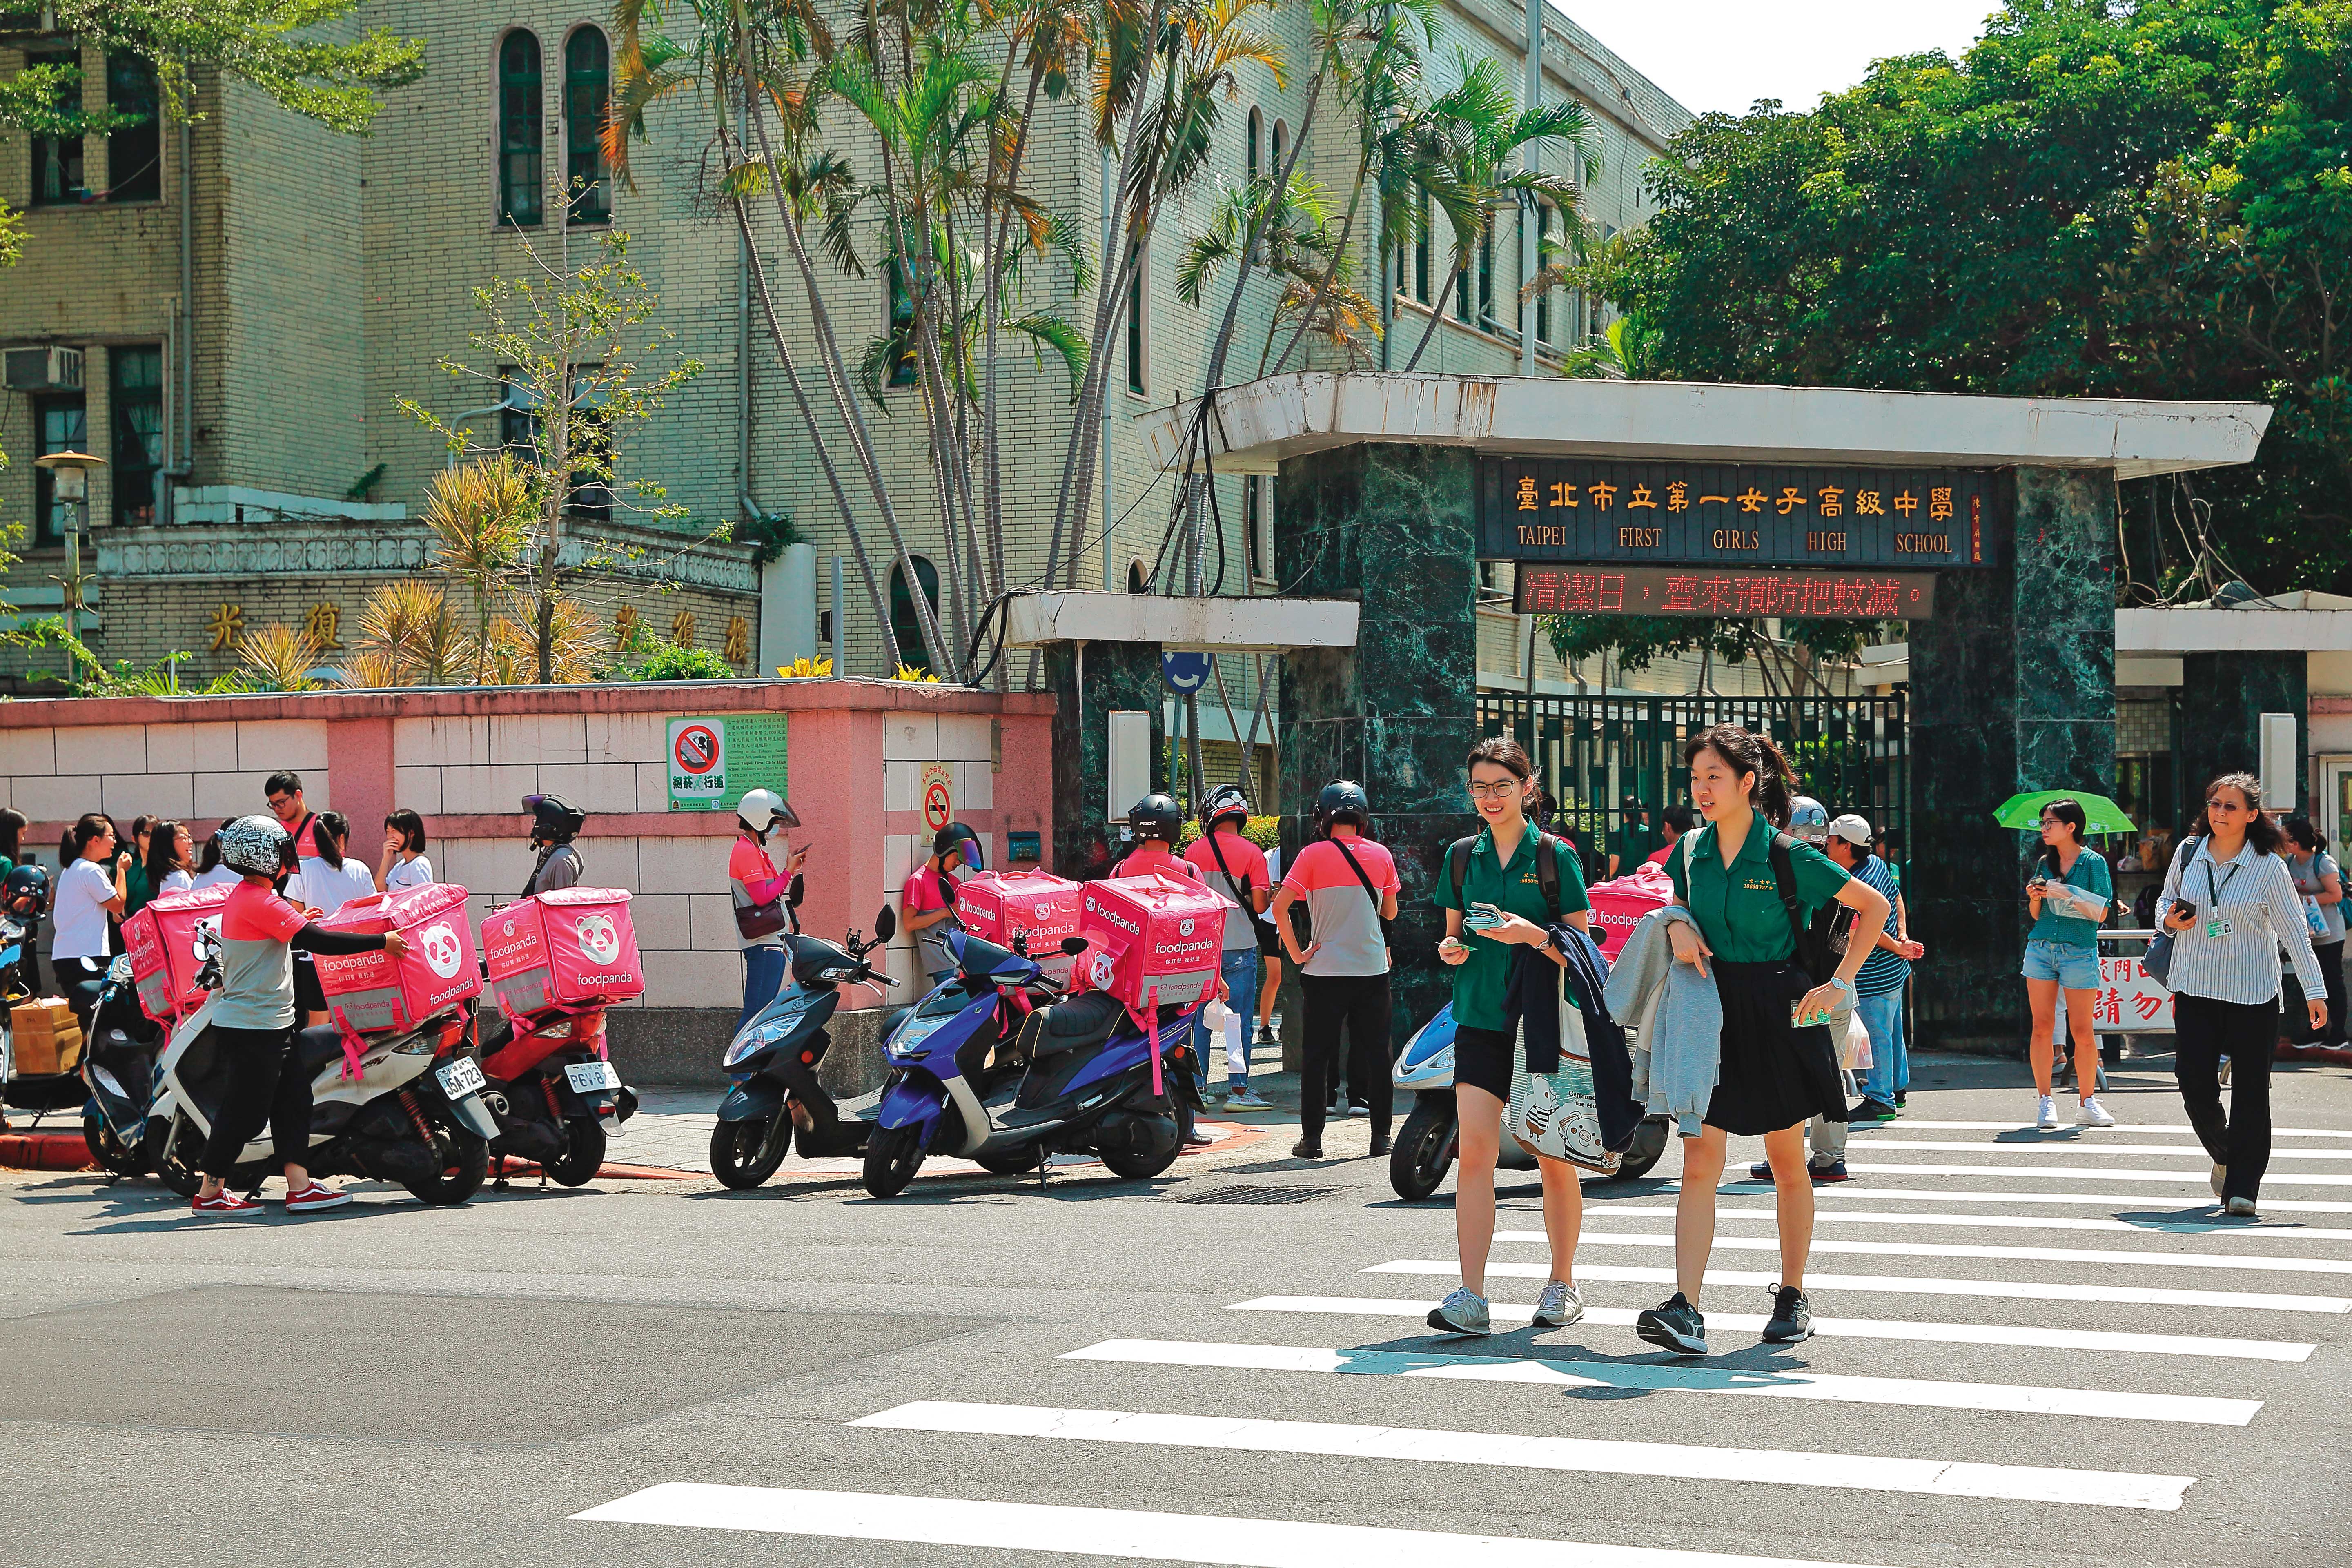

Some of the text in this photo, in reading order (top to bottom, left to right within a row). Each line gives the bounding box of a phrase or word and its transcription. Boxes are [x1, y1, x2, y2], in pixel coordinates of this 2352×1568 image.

[1517, 476, 1953, 521] 臺北市立第一女子高級中學
[1518, 526, 1953, 553] TAIPEI FIRST GIRLS HIGH SCHOOL
[967, 900, 996, 922] foodpanda
[1097, 902, 1140, 936] foodpanda
[1599, 910, 1641, 929] foodpa
[1012, 921, 1074, 940] foodpanda
[490, 933, 537, 960] foodpanda
[1155, 937, 1213, 955] foodpanda
[323, 951, 385, 972] foodpanda
[1041, 967, 1069, 976] odpanda
[513, 981, 542, 995] foodpanda
[577, 970, 633, 987] foodpanda
[1168, 981, 1201, 991] foodpanda
[430, 976, 474, 1007] foodpanda
[354, 1000, 390, 1010] foodpanda
[445, 1067, 482, 1095] J5A-723
